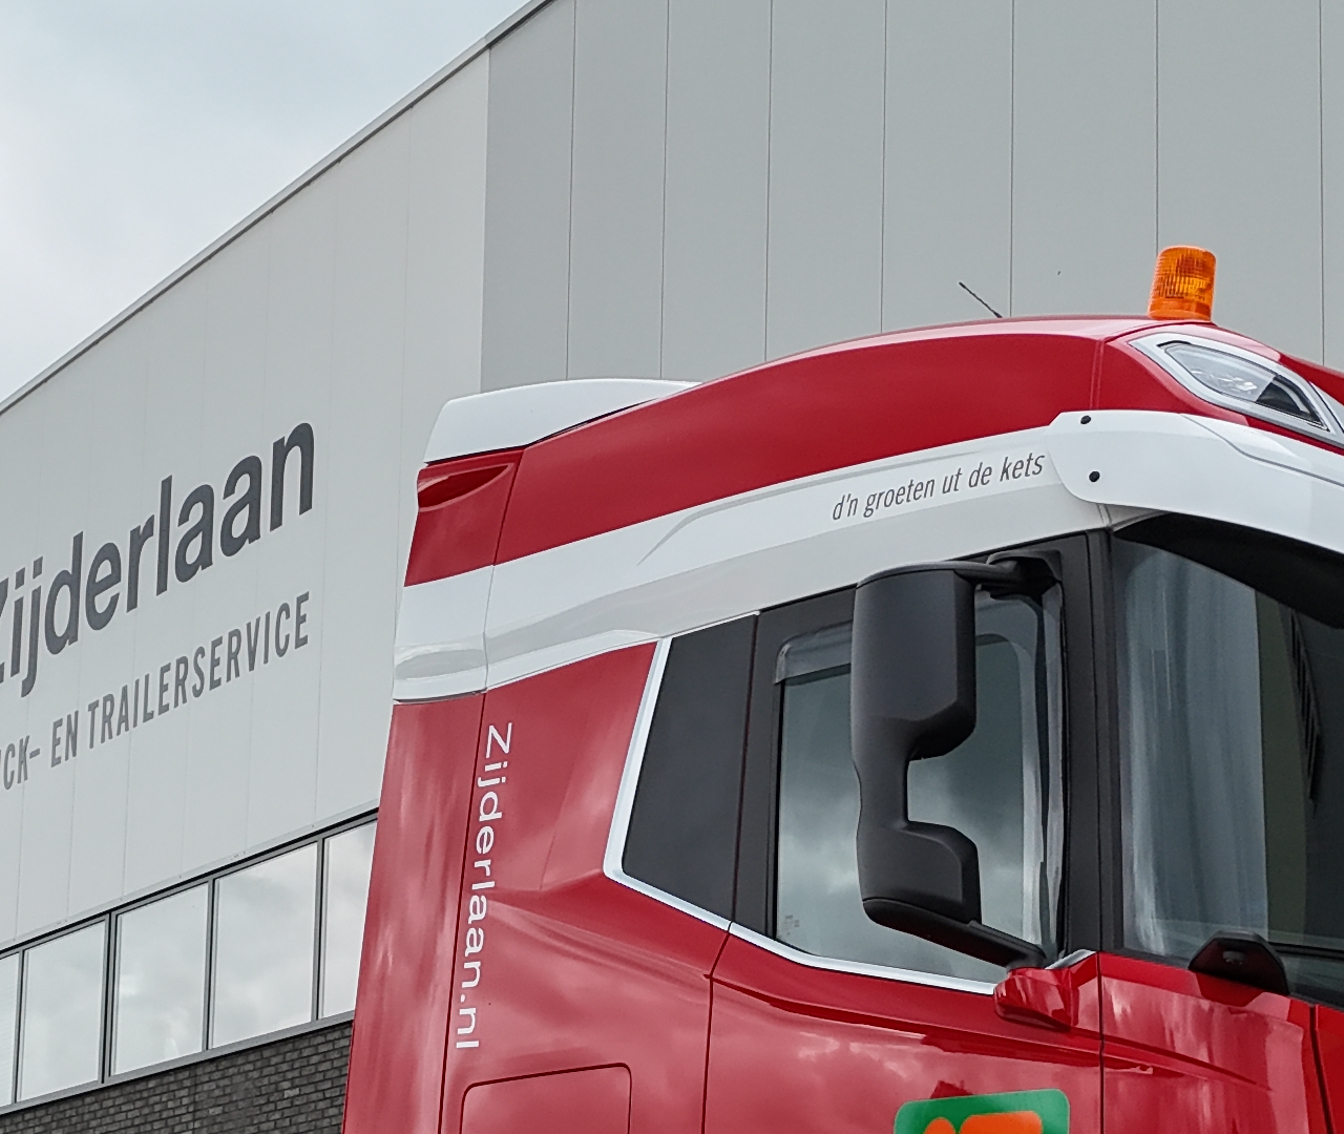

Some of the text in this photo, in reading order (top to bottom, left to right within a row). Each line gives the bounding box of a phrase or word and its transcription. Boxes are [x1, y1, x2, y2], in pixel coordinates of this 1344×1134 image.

[832, 452, 1045, 520] d'n groeten ut de kets
[50, 717, 78, 768] EN
[87, 591, 311, 751] TRAILERSERVICE
[456, 722, 513, 1049] Zijderlaan.nl
